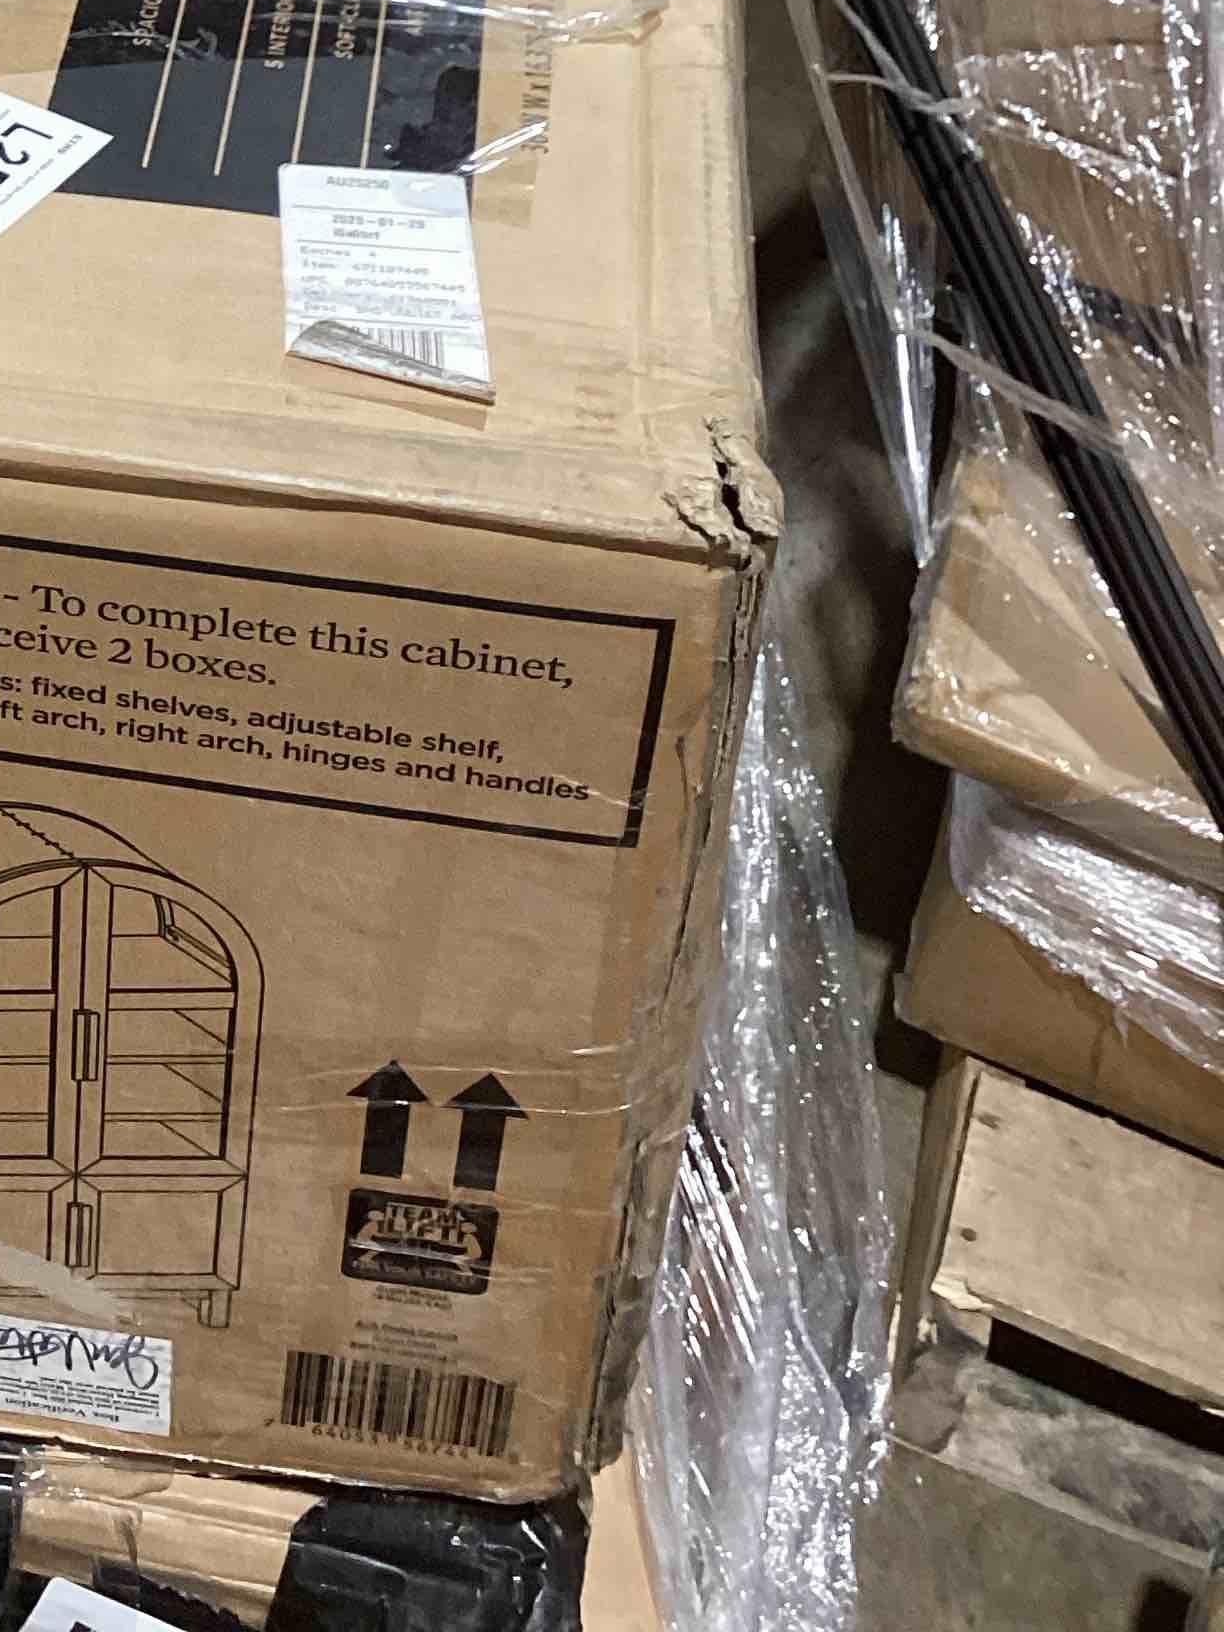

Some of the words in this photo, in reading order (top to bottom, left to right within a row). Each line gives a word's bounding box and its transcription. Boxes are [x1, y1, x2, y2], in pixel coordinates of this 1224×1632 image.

[32, 584, 86, 617] To
[98, 600, 297, 646] complete
[309, 622, 388, 659] this
[401, 638, 574, 689] cabinet,
[107, 638, 132, 664] 2
[145, 638, 276, 685] boxes.
[33, 677, 106, 705] fixed
[116, 690, 237, 726] shelves,
[248, 710, 412, 748] adjustable
[422, 730, 504, 764] shelf,
[33, 706, 106, 736] arch,
[116, 718, 187, 745] right
[197, 734, 274, 760] arch,
[283, 741, 386, 775] hinges
[395, 756, 456, 782] and
[465, 766, 590, 801] handles
[5, 1397, 85, 1417] Verification
